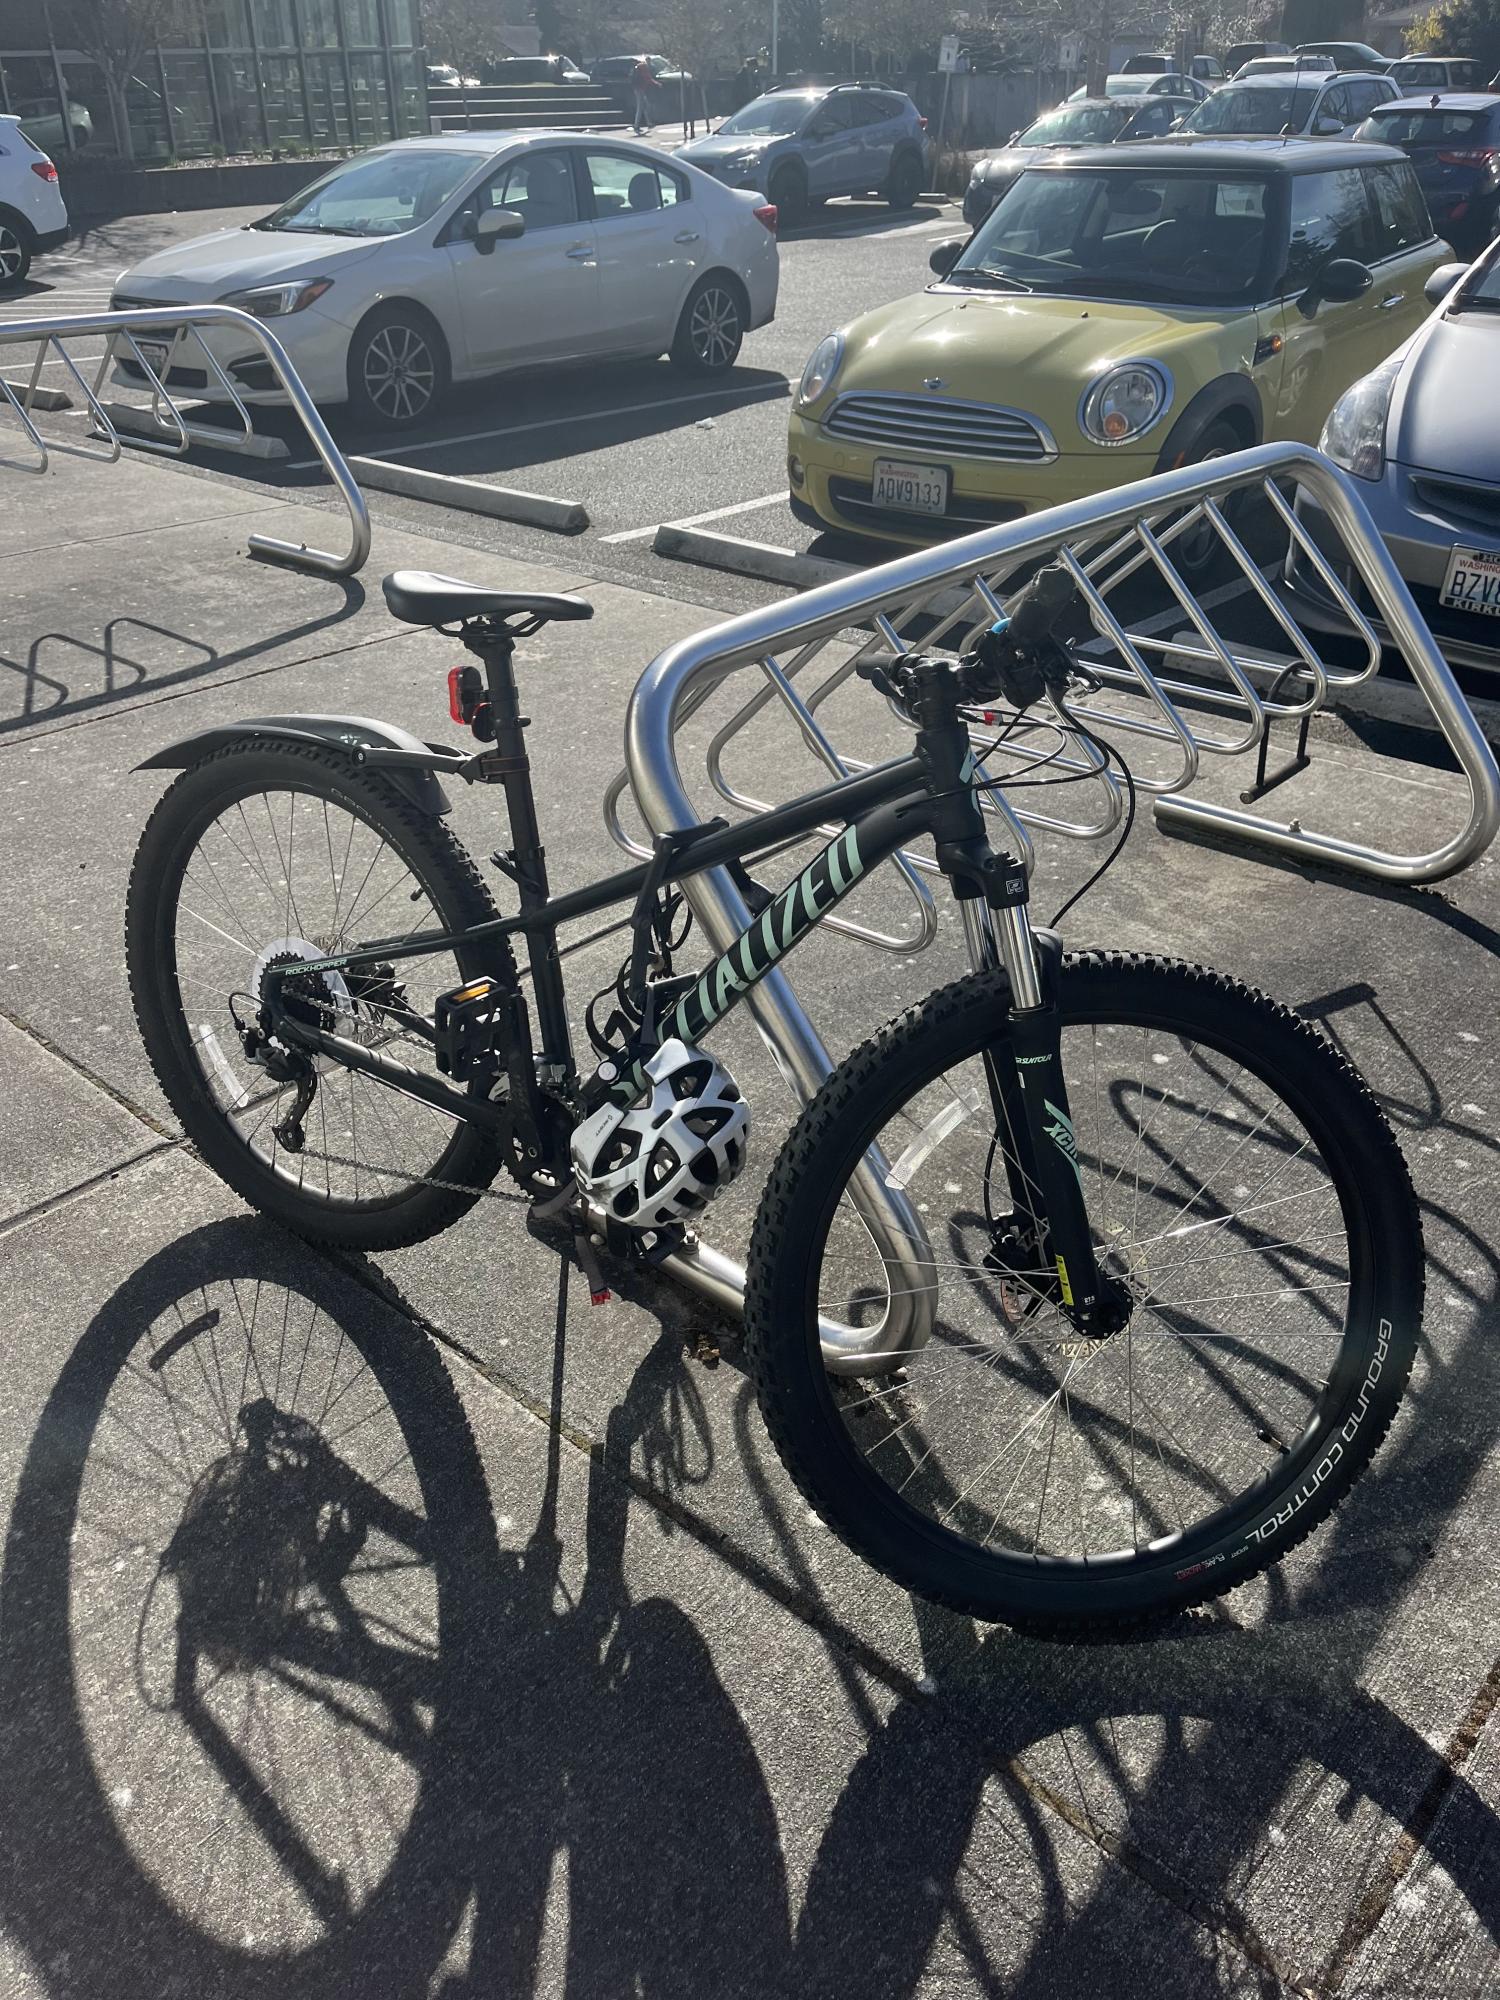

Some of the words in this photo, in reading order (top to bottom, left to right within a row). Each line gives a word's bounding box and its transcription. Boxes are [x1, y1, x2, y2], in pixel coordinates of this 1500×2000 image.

[285, 959, 348, 976] ROCKHOPPER
[1341, 1318, 1393, 1442] GROUND
[1245, 1442, 1344, 1543] CONTROL
